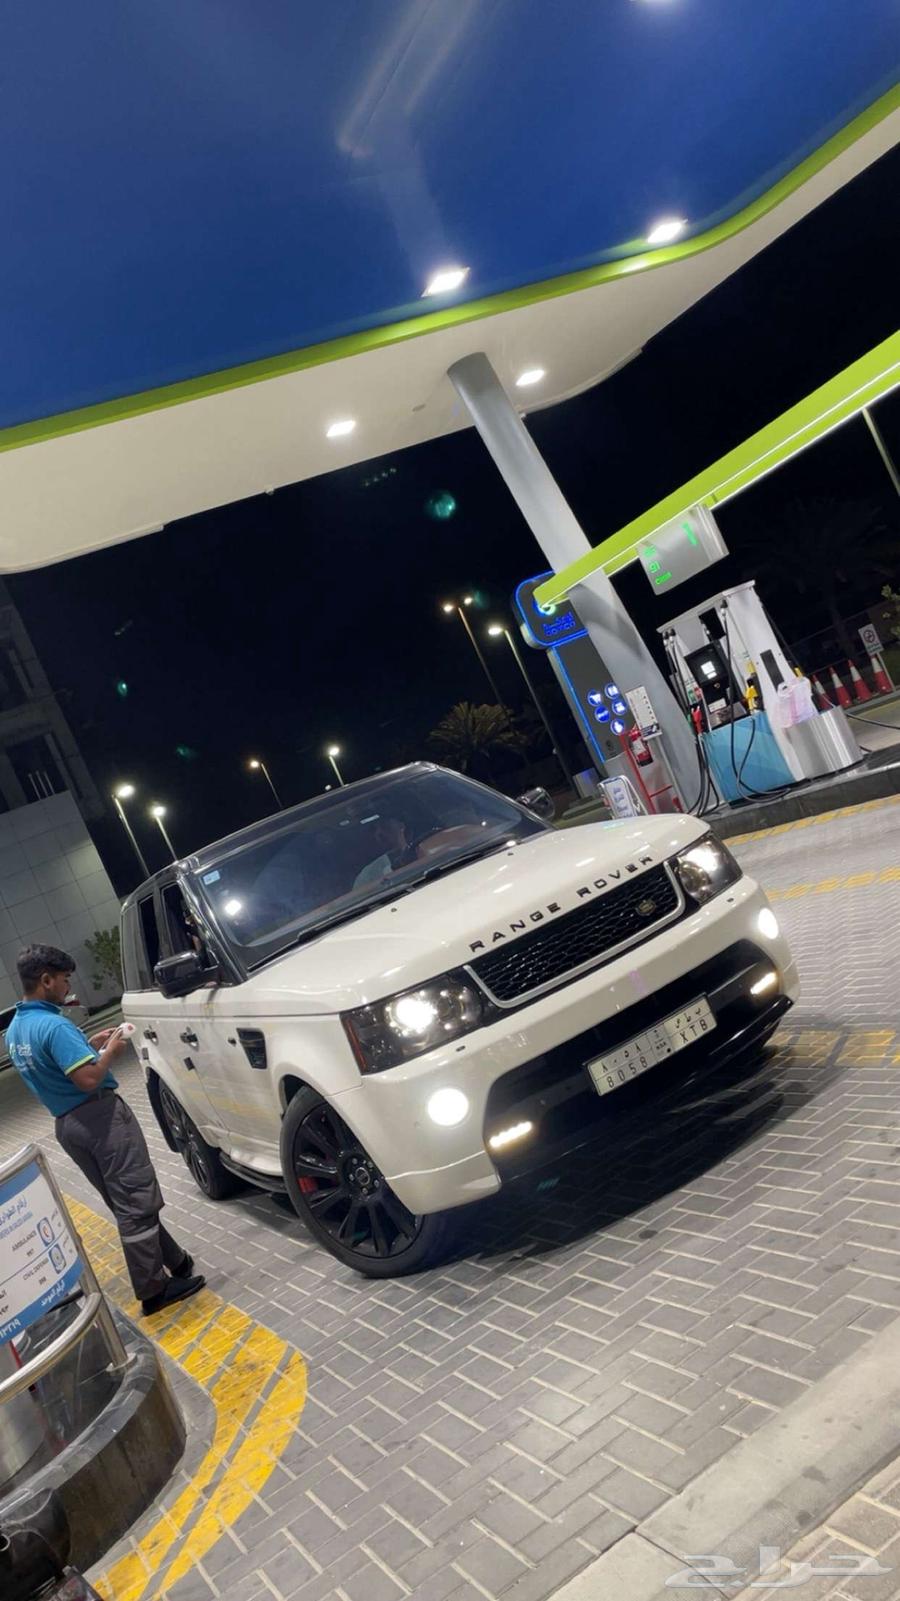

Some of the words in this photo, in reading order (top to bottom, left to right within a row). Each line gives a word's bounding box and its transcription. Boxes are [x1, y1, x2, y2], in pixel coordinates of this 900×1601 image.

[469, 902, 561, 953] RANGE
[576, 856, 654, 898] ROVER
[607, 1056, 648, 1088] 8058
